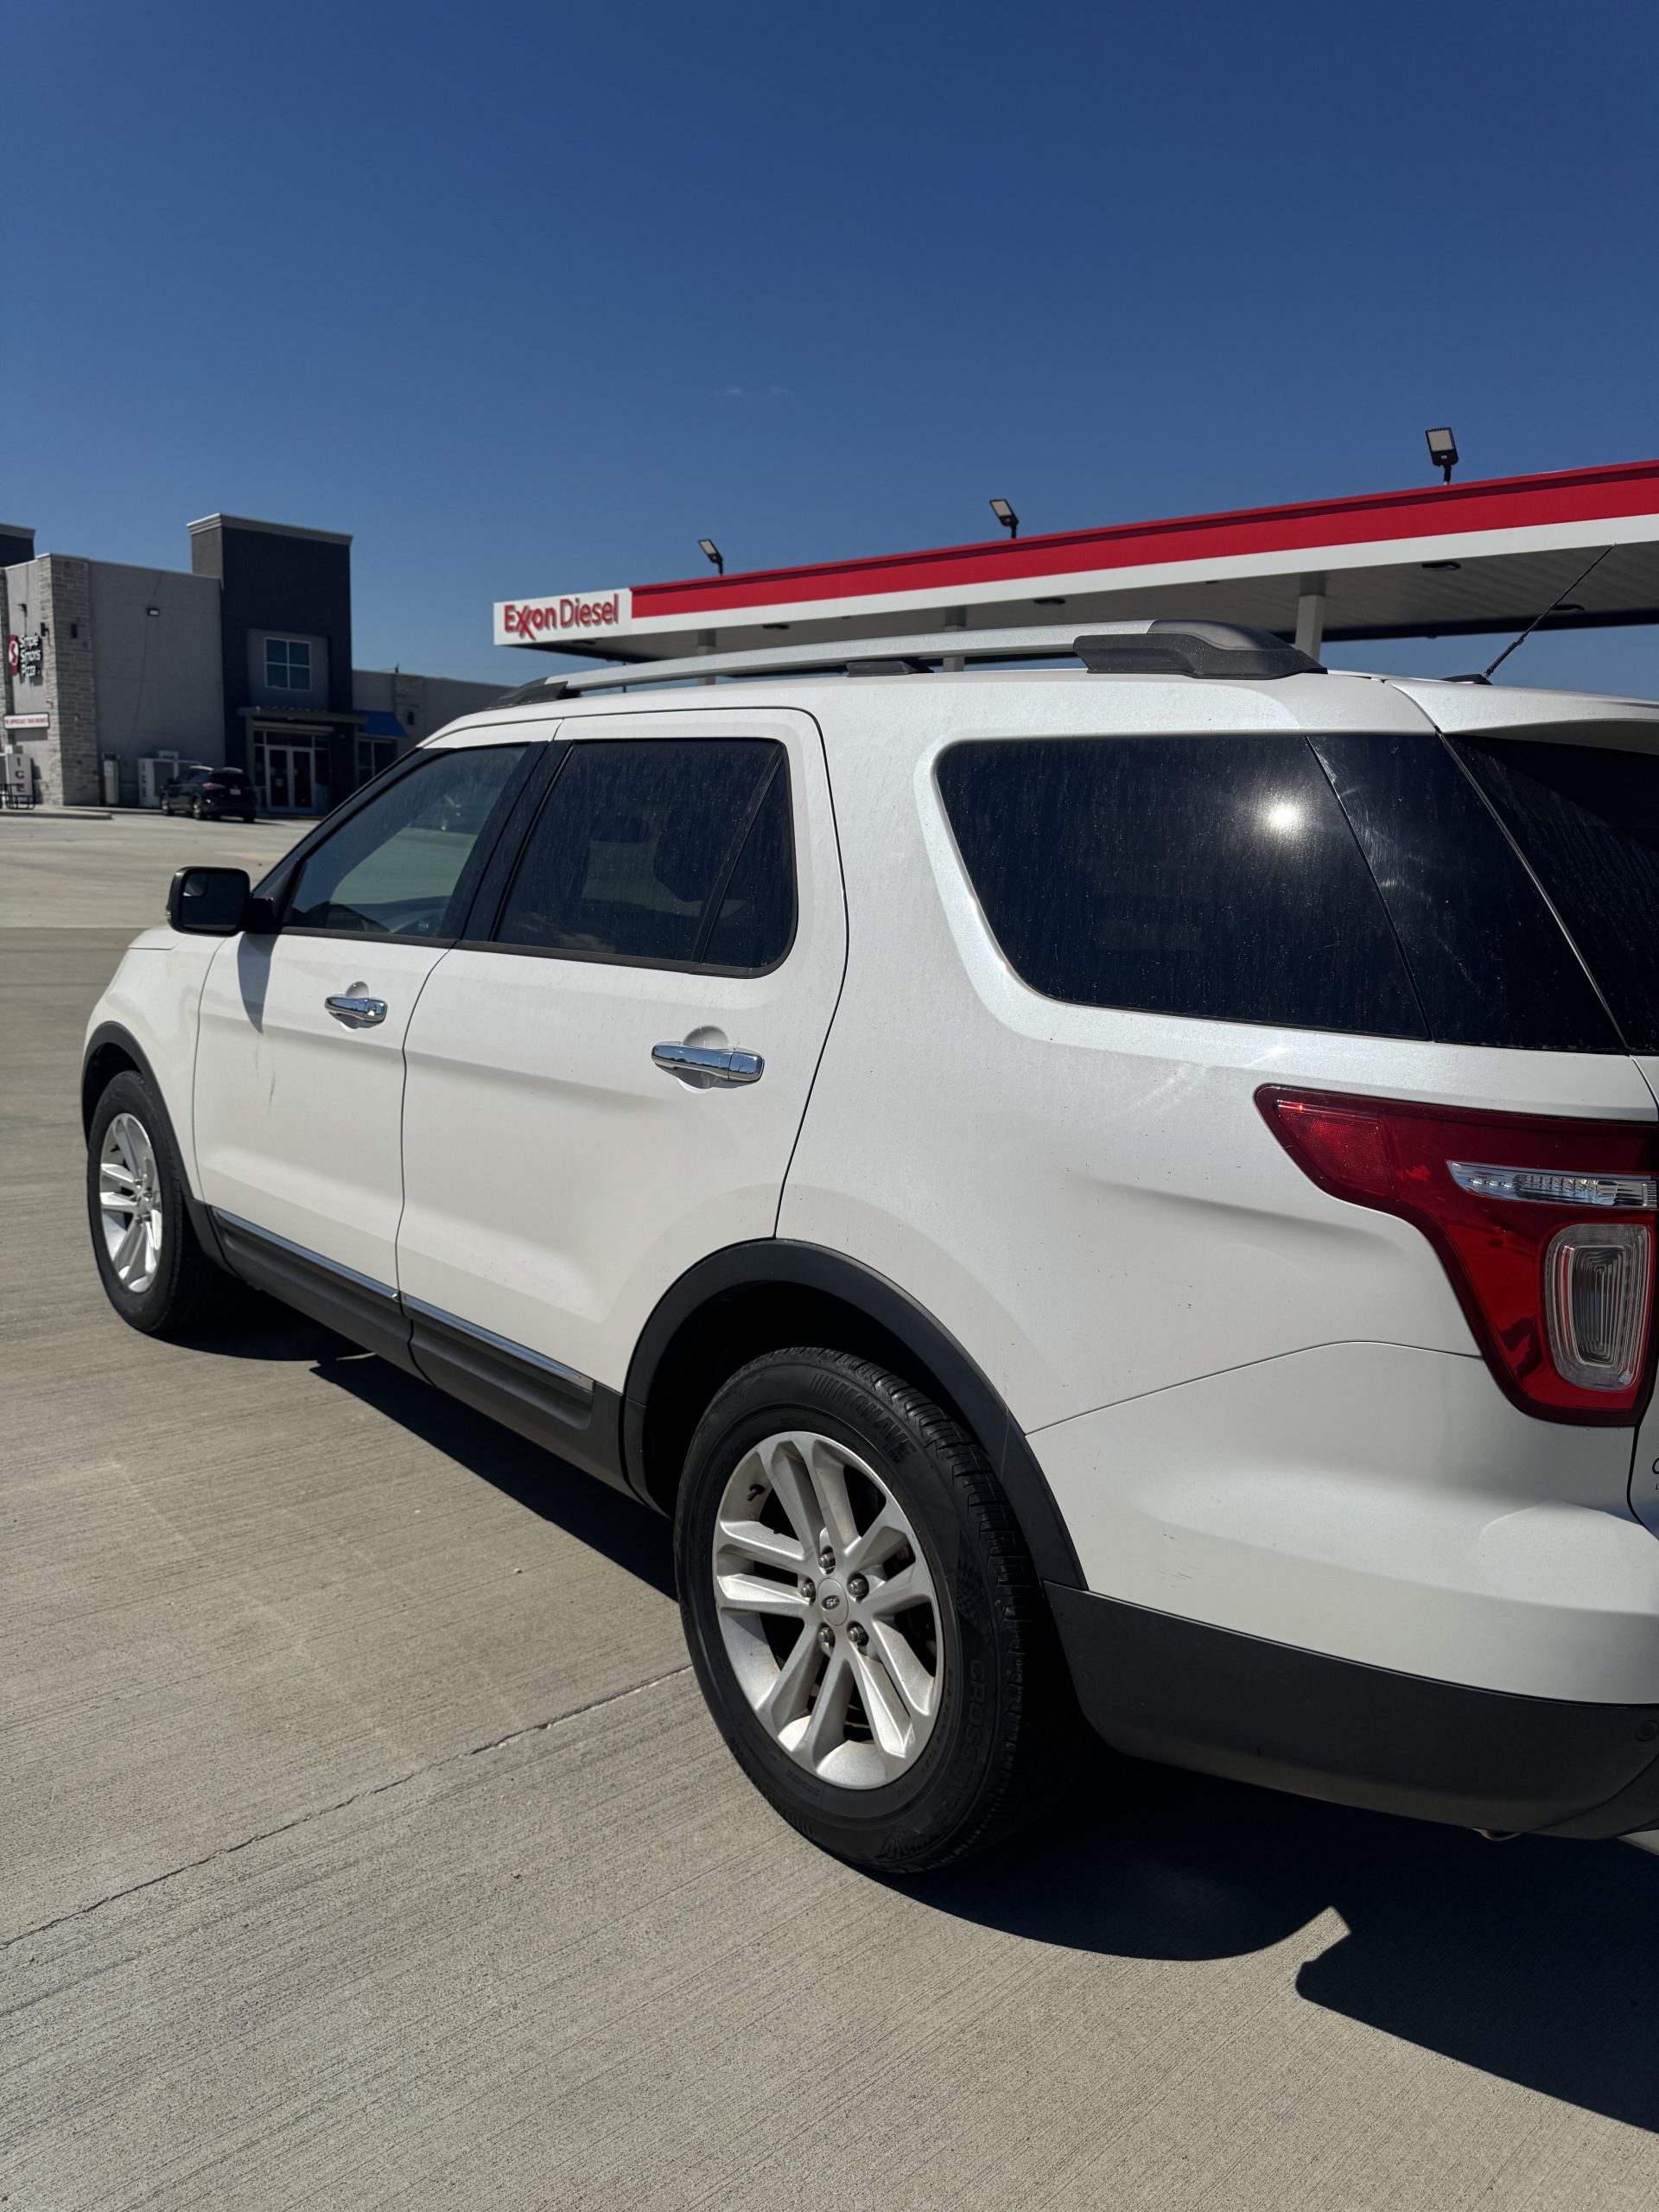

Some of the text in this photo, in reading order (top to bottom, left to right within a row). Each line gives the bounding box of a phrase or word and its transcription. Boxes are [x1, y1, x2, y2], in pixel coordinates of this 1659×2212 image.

[504, 594, 619, 640] Exxon Diesel
[21, 664, 36, 677] Pizza
[15, 757, 26, 793] ICE
